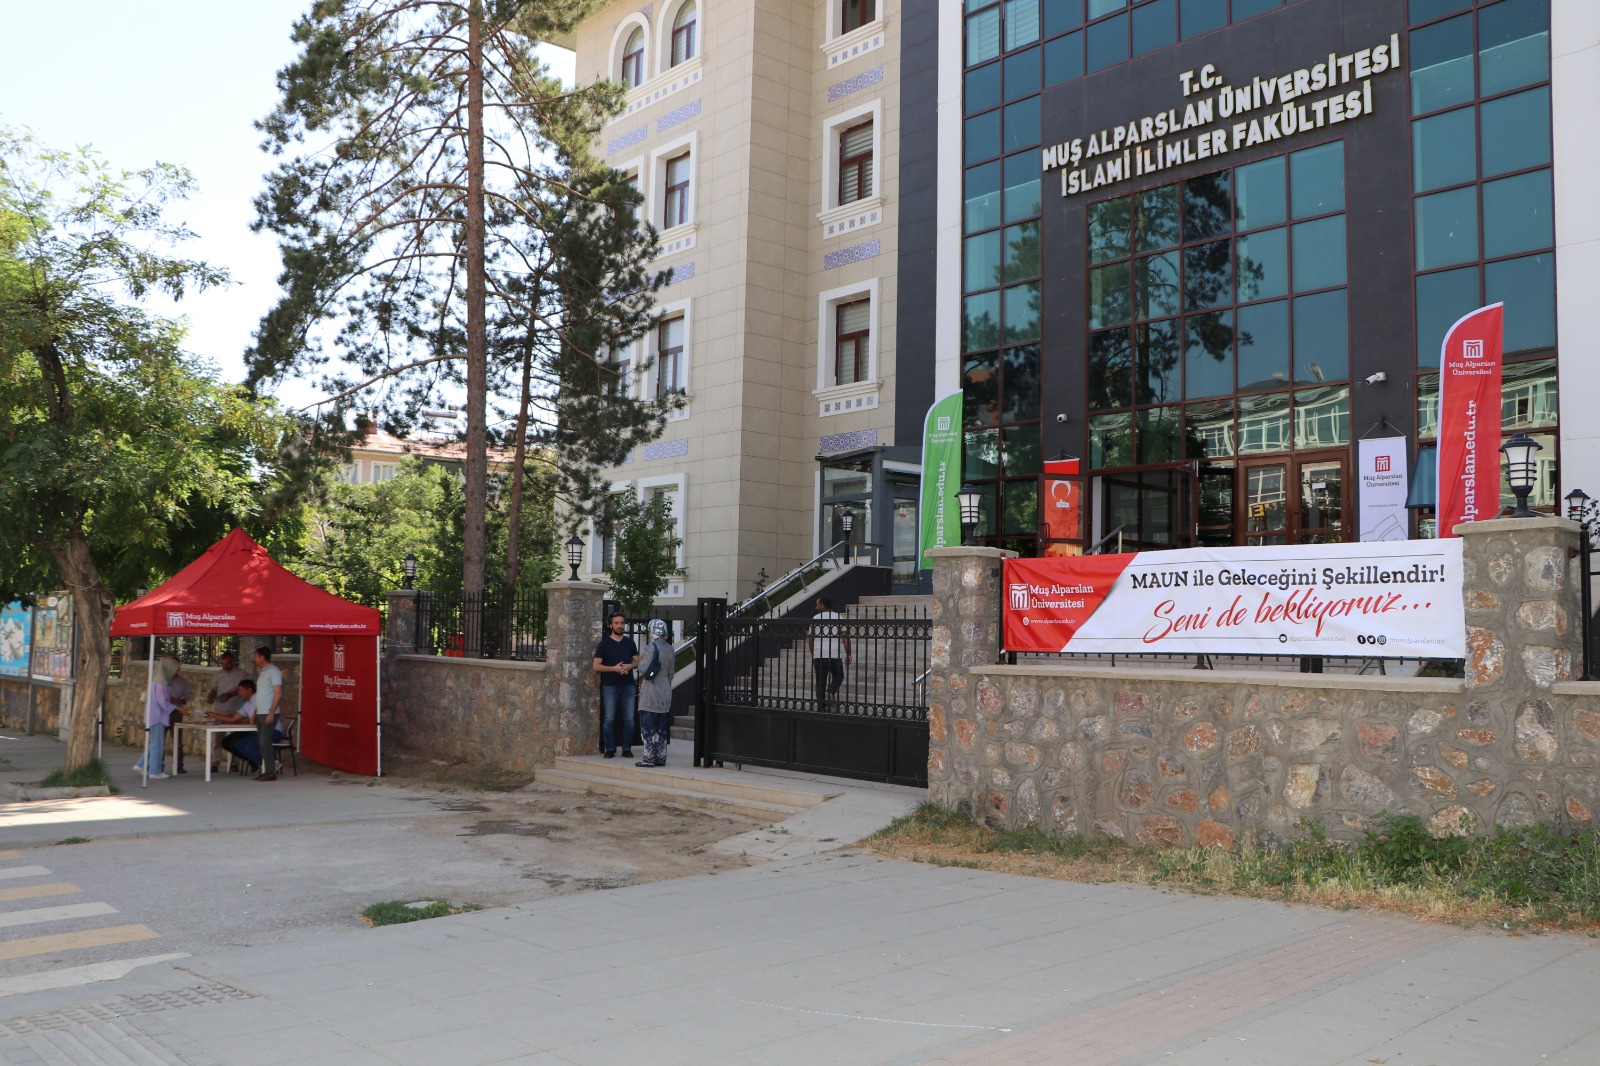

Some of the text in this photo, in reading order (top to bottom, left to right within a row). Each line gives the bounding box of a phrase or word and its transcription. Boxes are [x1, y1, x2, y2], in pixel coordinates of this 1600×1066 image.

[1179, 63, 1223, 97] T.C.
[1042, 32, 1400, 172] MUŞ ALPARSLAN ÜNİVERSİTESİ
[1061, 79, 1373, 197] İSLAMİ İLİMLER FAKÜLTESİ
[1029, 583, 1094, 597] Muş Alparslan
[1130, 564, 1445, 591] MAUN ile Geleceğini Şekillendir!
[1031, 597, 1085, 609] Üniversitesi
[1142, 587, 1432, 644] Seni de bekliyoruz...
